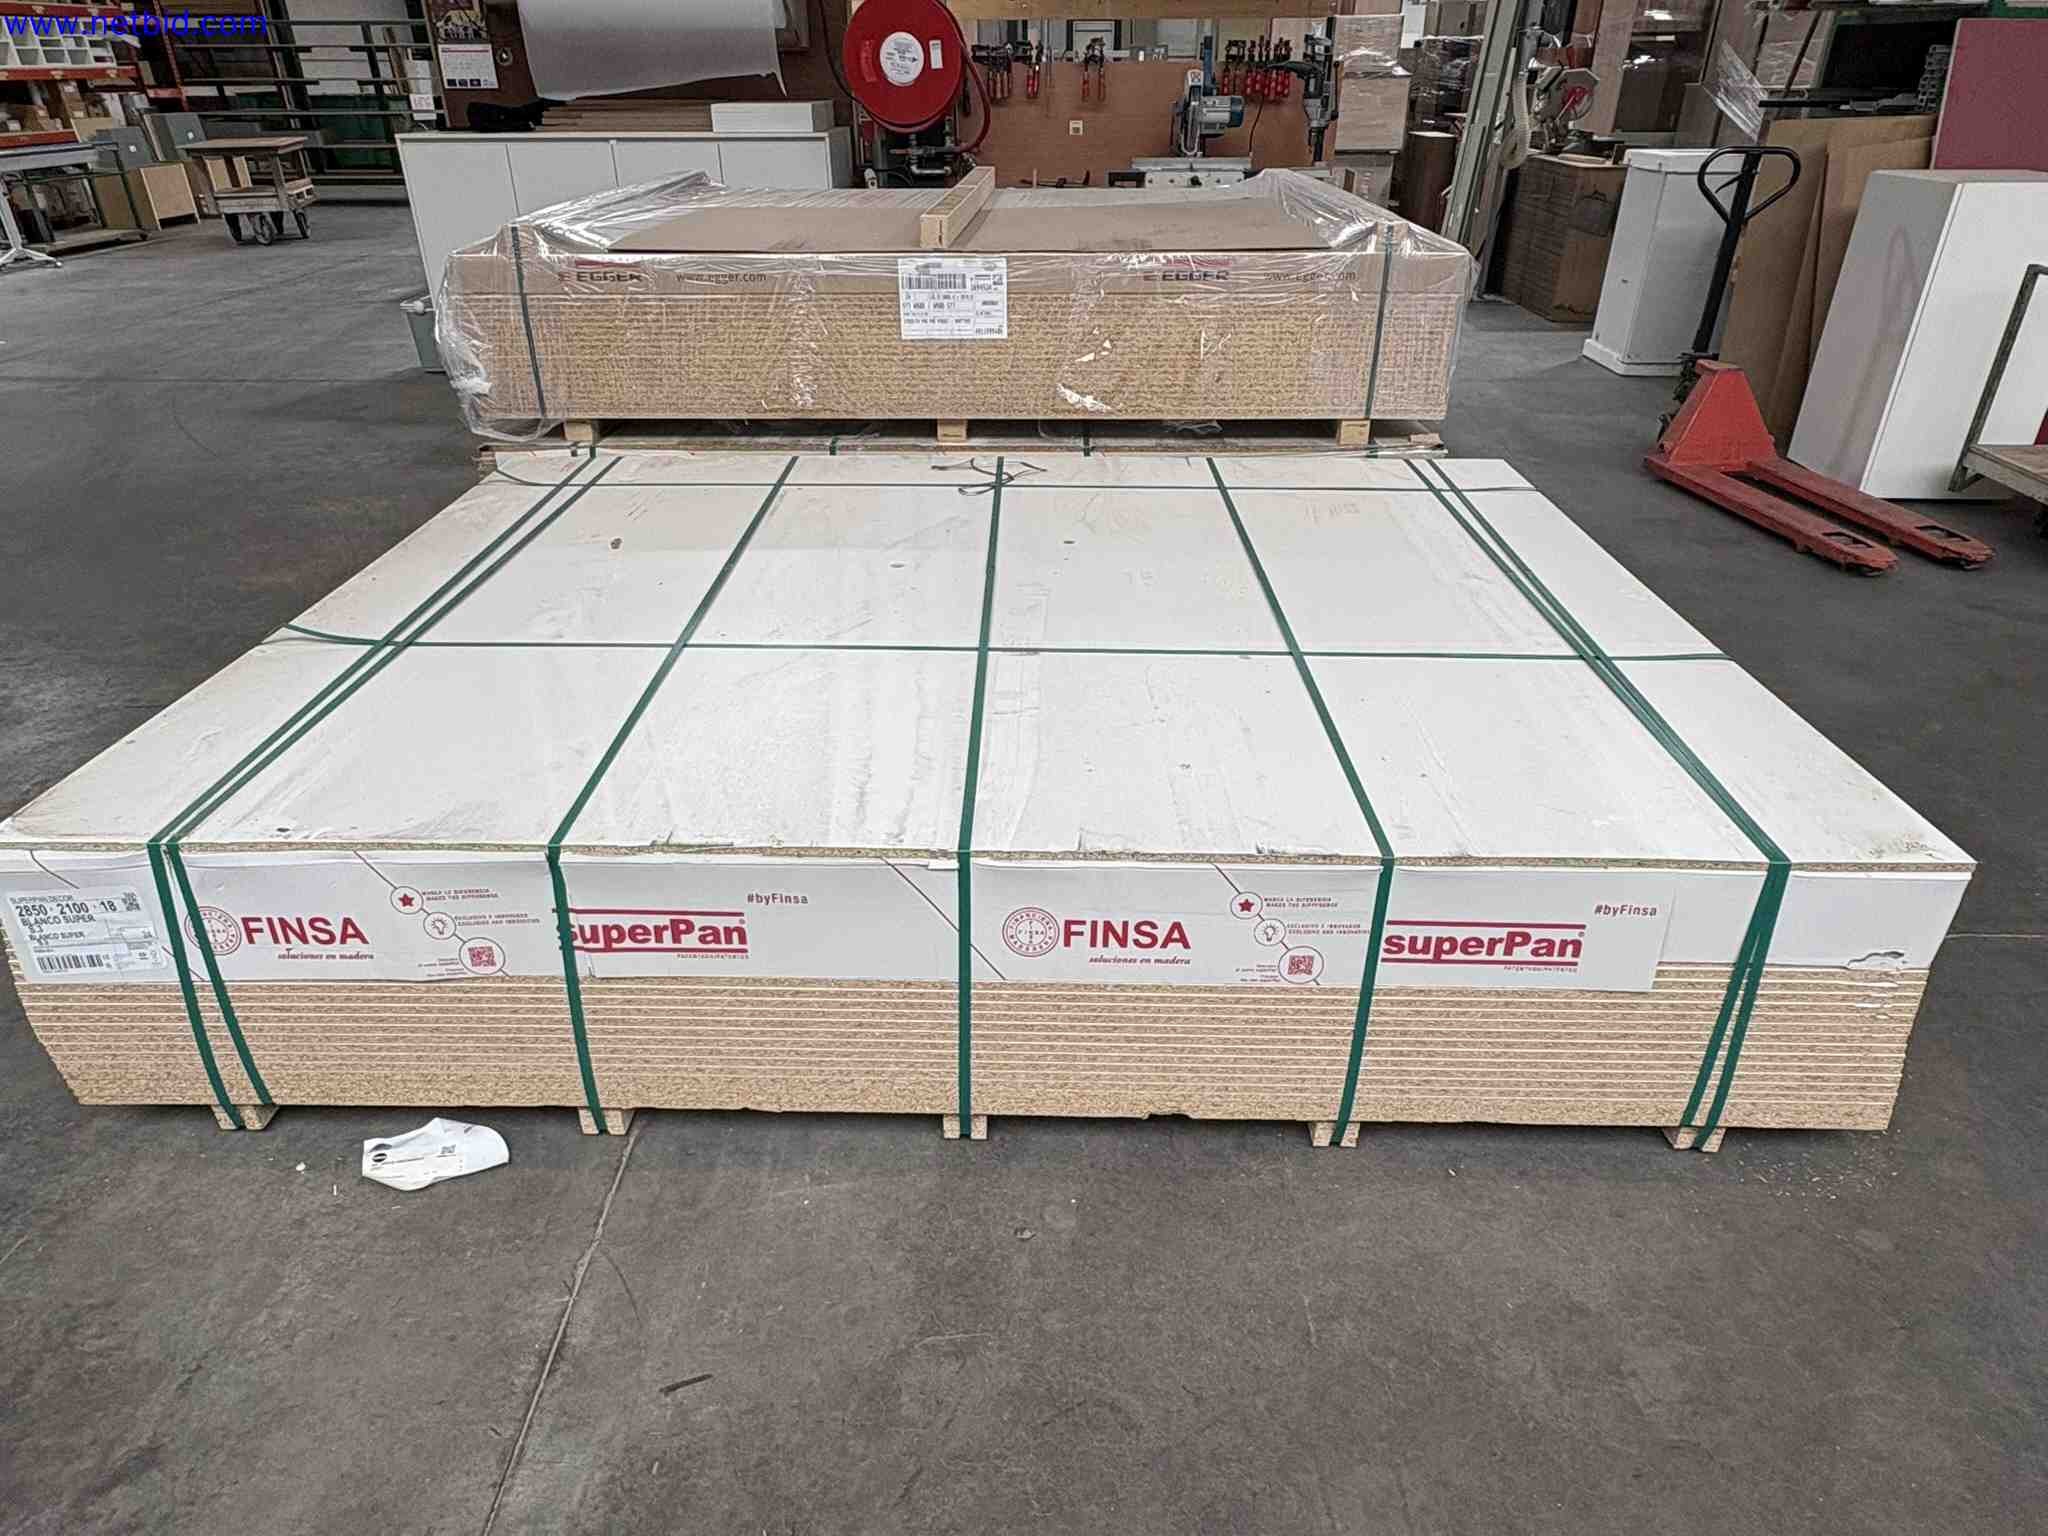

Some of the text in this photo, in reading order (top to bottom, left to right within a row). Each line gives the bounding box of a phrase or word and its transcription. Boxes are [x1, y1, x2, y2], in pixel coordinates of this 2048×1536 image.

[576, 271, 643, 282] EGGER
[1161, 270, 1230, 281] EGGER
[747, 893, 809, 905] #byFinsa
[15, 900, 117, 917] 2850 2100 18
[1594, 904, 1657, 916] #byFinsa
[21, 914, 97, 927] BLANCO SUPER
[240, 917, 370, 946] FINSA
[1063, 919, 1192, 950] FINSA
[1382, 931, 1583, 961] superPan
[278, 947, 323, 960] soluciones
[339, 951, 374, 960] madera
[1089, 954, 1138, 964] soluciones
[1154, 956, 1191, 965] madera
